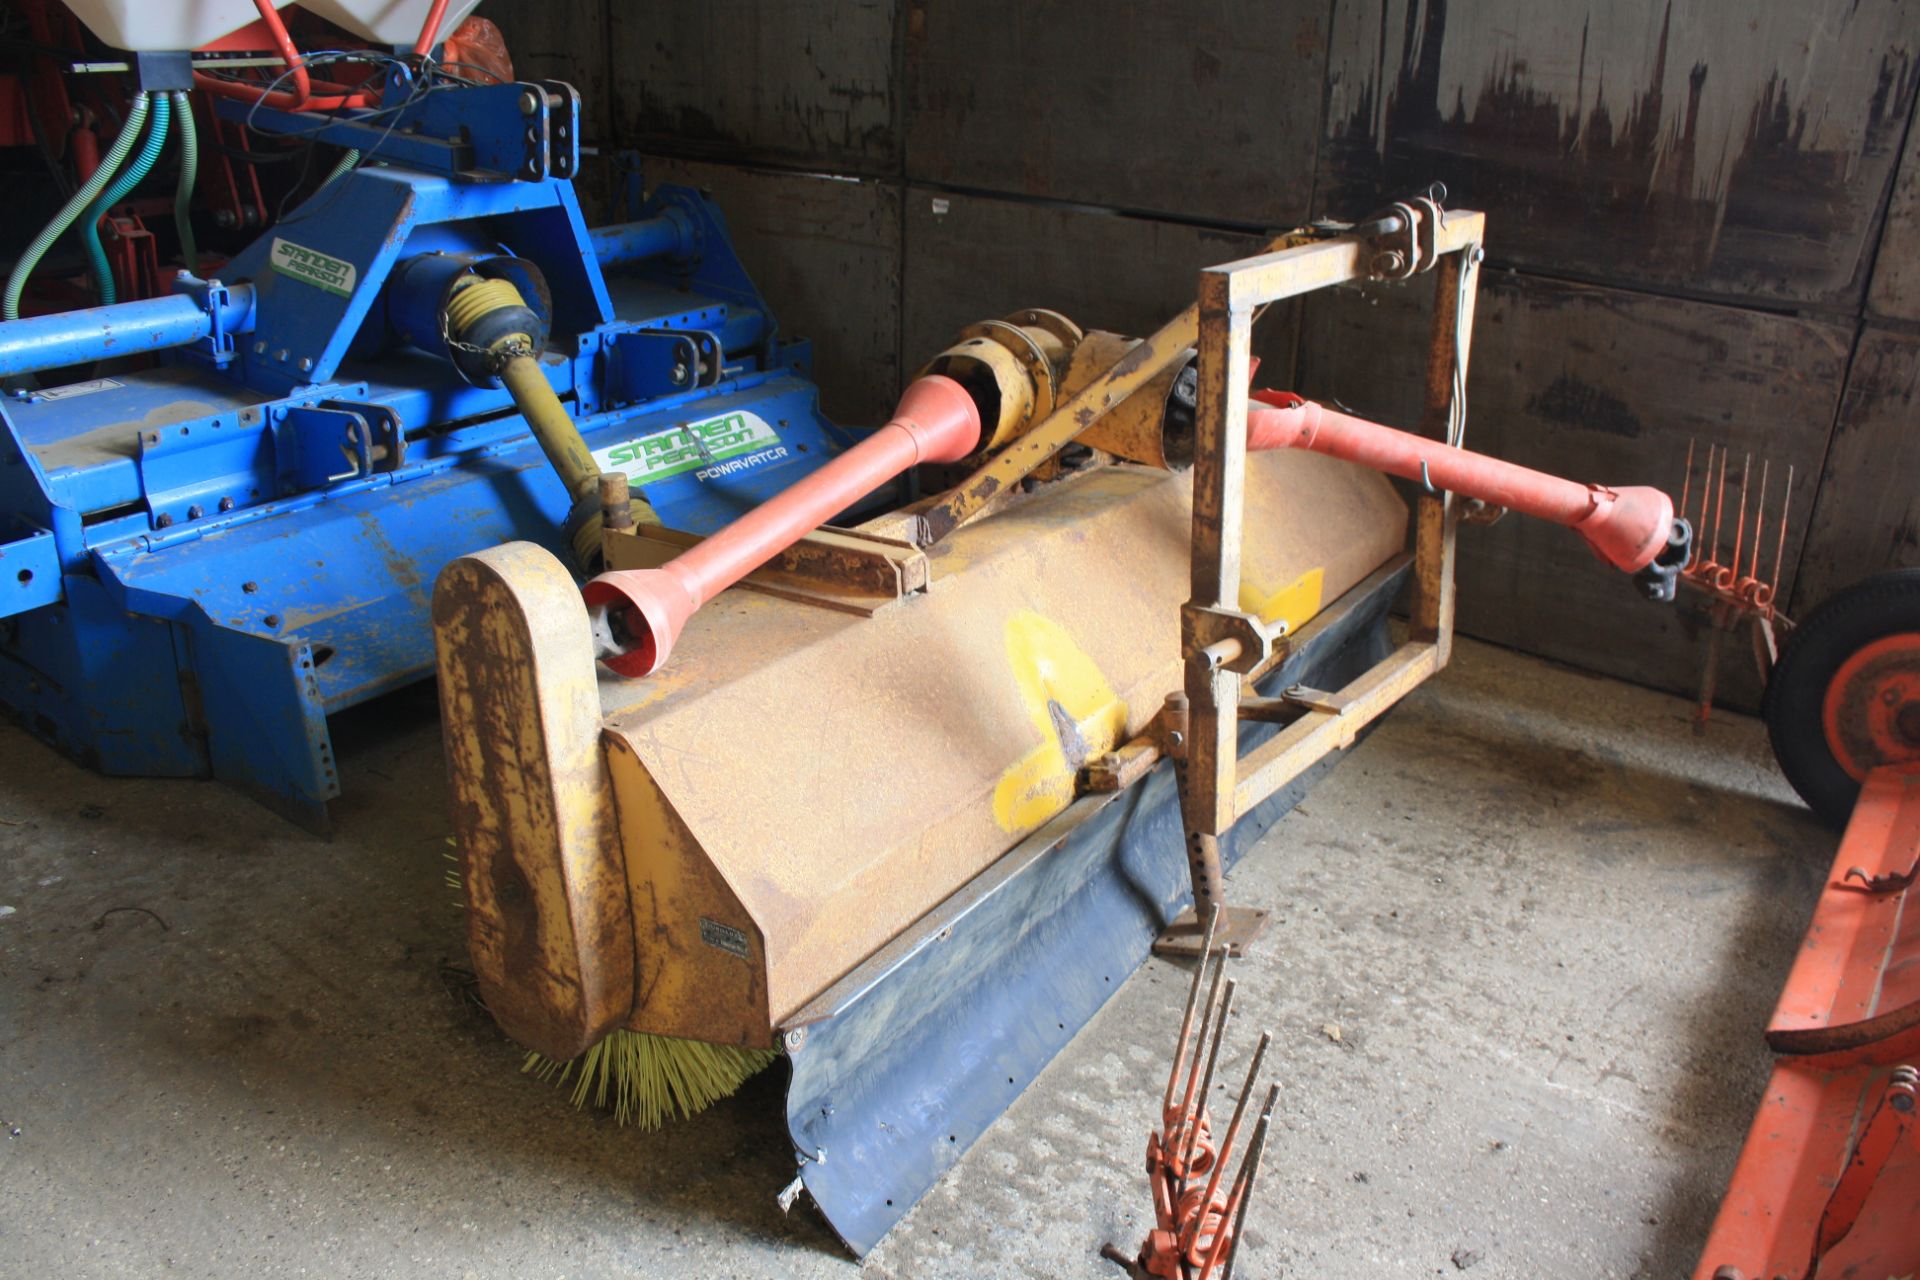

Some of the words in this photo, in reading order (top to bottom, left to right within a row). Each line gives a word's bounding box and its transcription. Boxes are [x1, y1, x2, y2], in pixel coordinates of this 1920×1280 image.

[277, 243, 351, 277] STANDEN
[608, 413, 745, 466] STANDEN
[645, 428, 754, 470] PEASON
